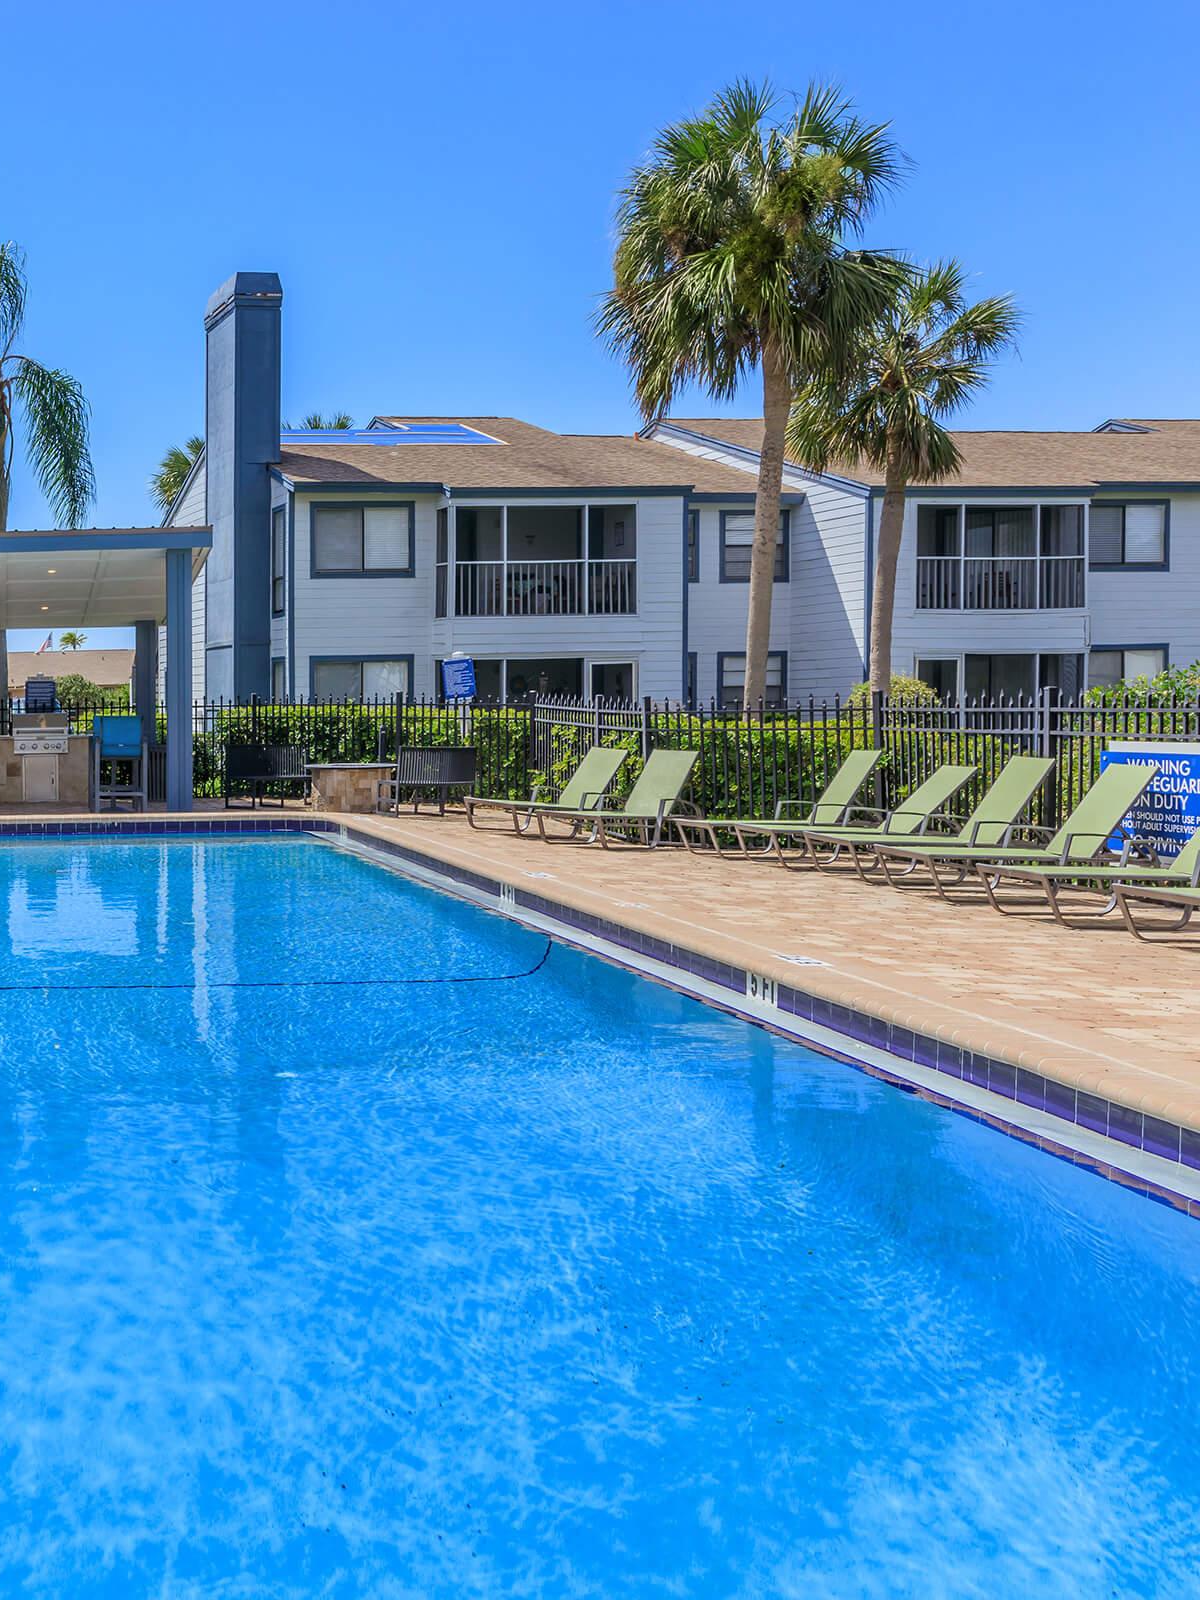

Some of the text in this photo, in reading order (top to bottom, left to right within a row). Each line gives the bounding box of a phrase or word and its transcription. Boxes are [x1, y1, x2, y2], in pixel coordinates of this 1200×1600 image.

[1154, 794, 1189, 811] DUTY
[1136, 811, 1164, 821] SHOULD
[1165, 814, 1180, 823] NOT
[1181, 815, 1195, 825] USE
[1142, 821, 1163, 832] ADULT
